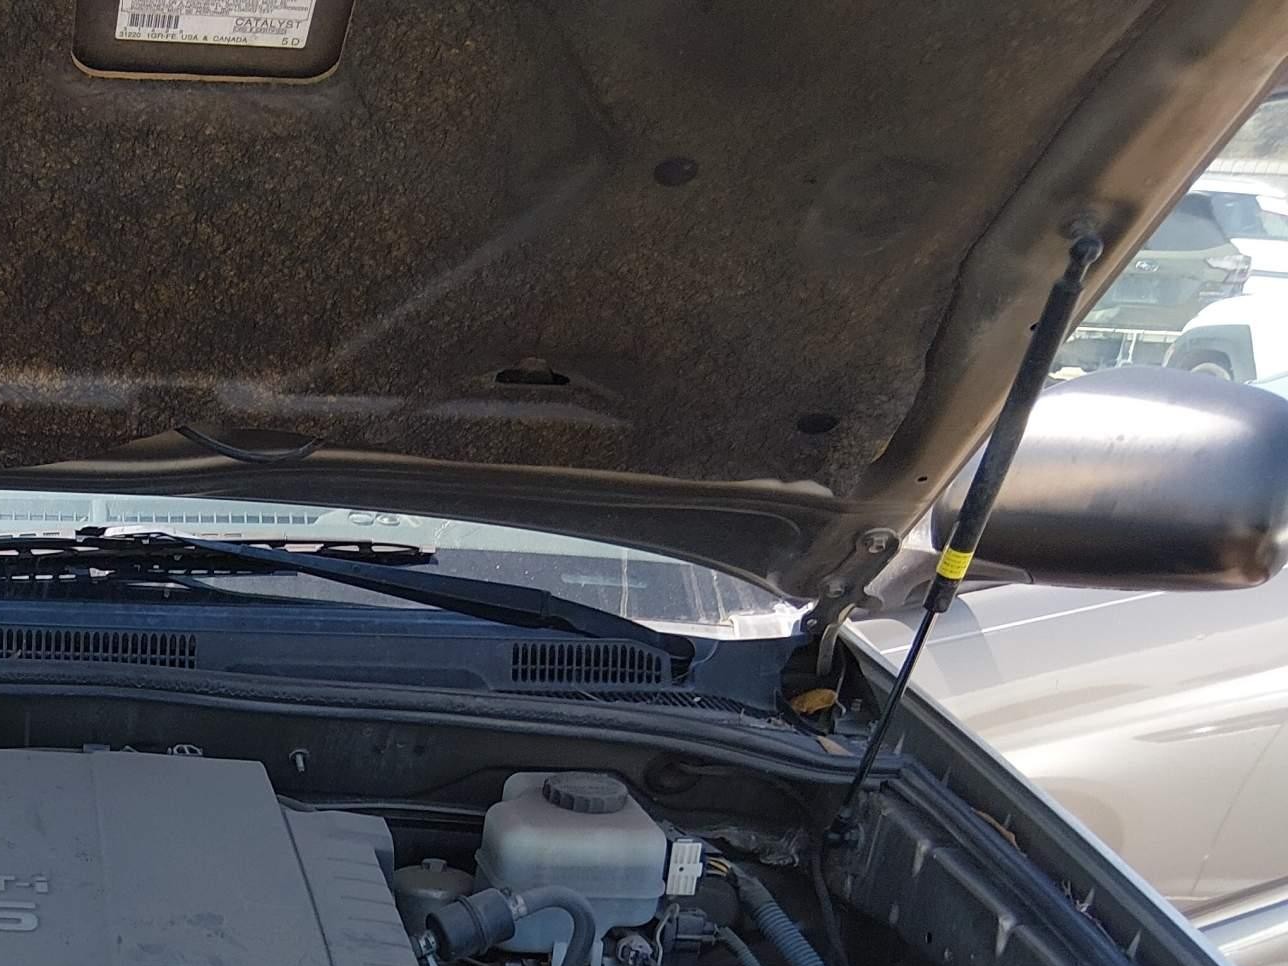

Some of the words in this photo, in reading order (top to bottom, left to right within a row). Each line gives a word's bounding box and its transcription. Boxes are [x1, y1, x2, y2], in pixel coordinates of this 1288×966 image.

[234, 17, 303, 29] CATALYST
[181, 33, 198, 41] USA
[213, 35, 248, 44] CANADA
